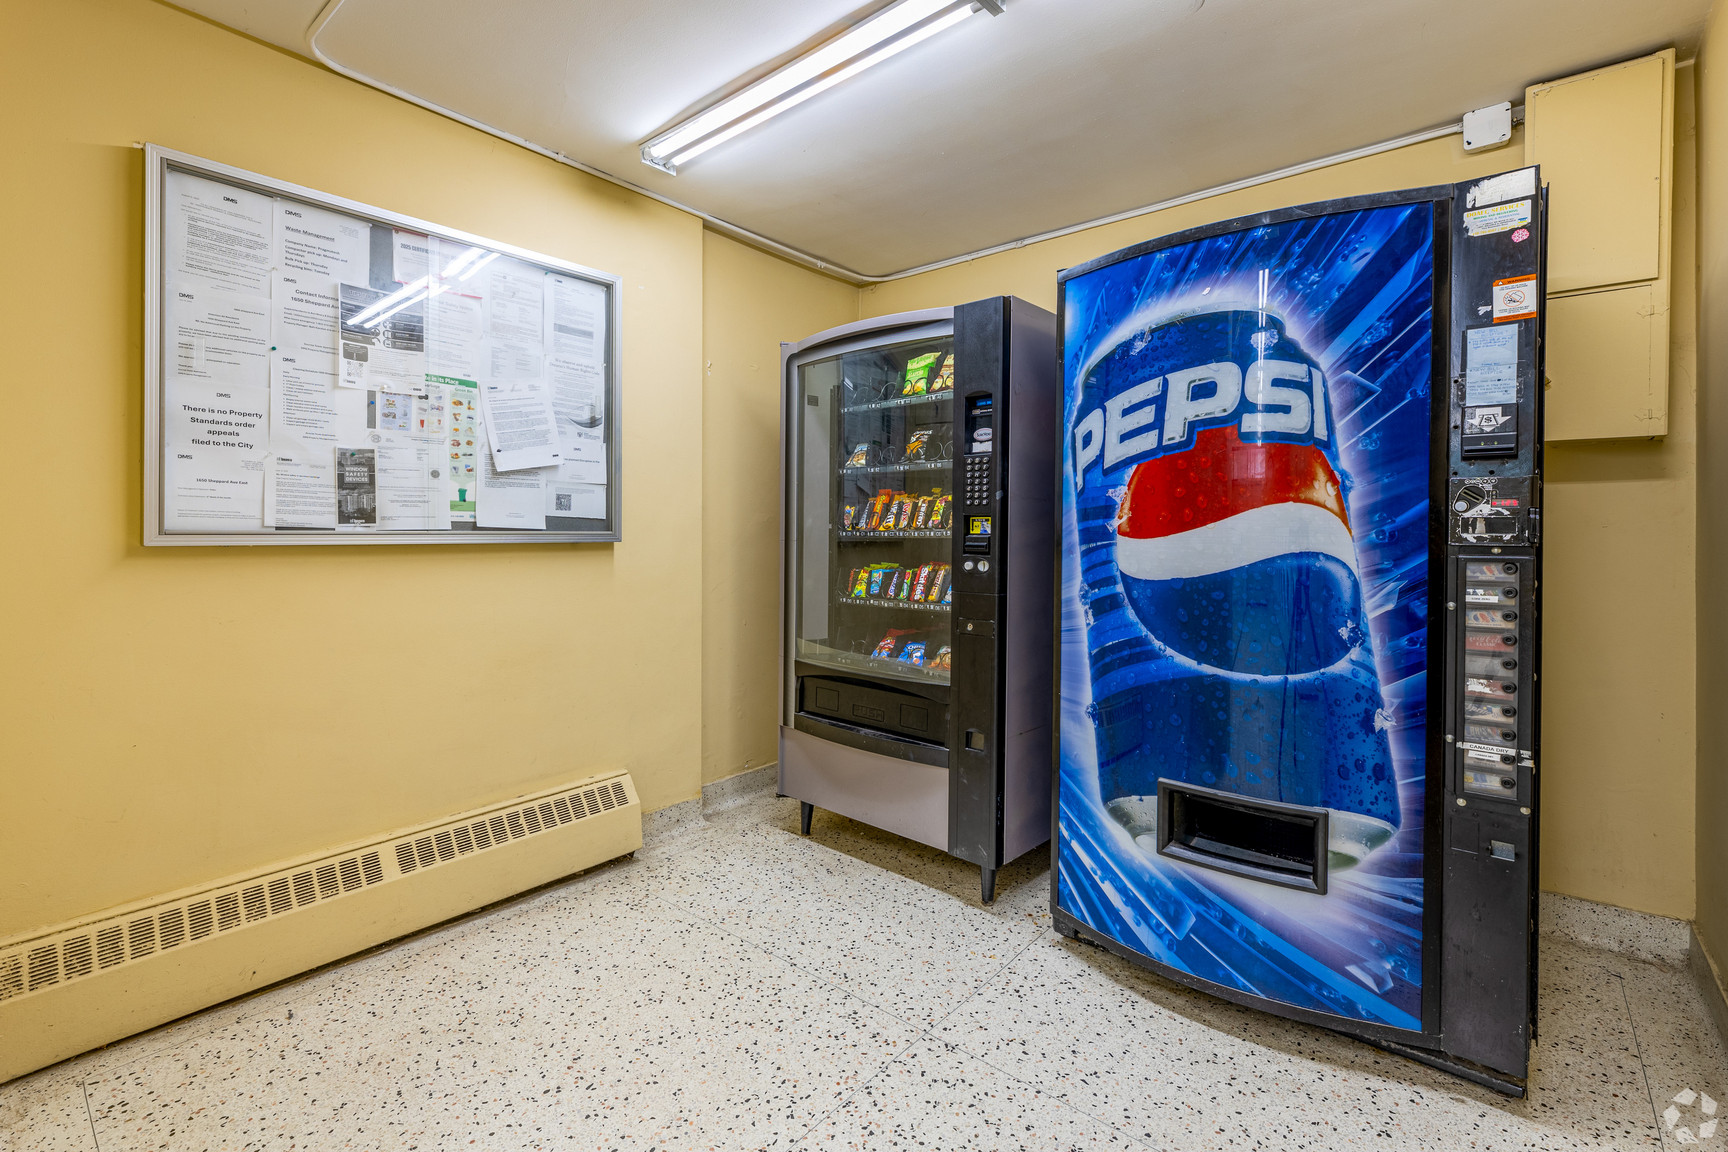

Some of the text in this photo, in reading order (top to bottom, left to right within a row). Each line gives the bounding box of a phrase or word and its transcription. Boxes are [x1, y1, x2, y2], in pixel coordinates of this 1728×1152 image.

[223, 196, 238, 205] DMS
[1491, 202, 1525, 212] SERVICES
[285, 210, 302, 218] DMS
[285, 225, 301, 233] Waste
[302, 229, 335, 241] Management
[285, 239, 303, 247] Company
[285, 263, 303, 271] Recycling
[310, 262, 328, 270] Thursday
[295, 289, 318, 298] Contact
[305, 299, 330, 308] Sheppard
[182, 404, 206, 413] There
[229, 409, 263, 419] Property
[190, 417, 256, 429] Standards order
[1074, 359, 1328, 492] PEPSI
[207, 429, 240, 437] appeals
[191, 438, 211, 446] filed
[237, 442, 254, 450] City
[1470, 744, 1495, 752] CANADA
